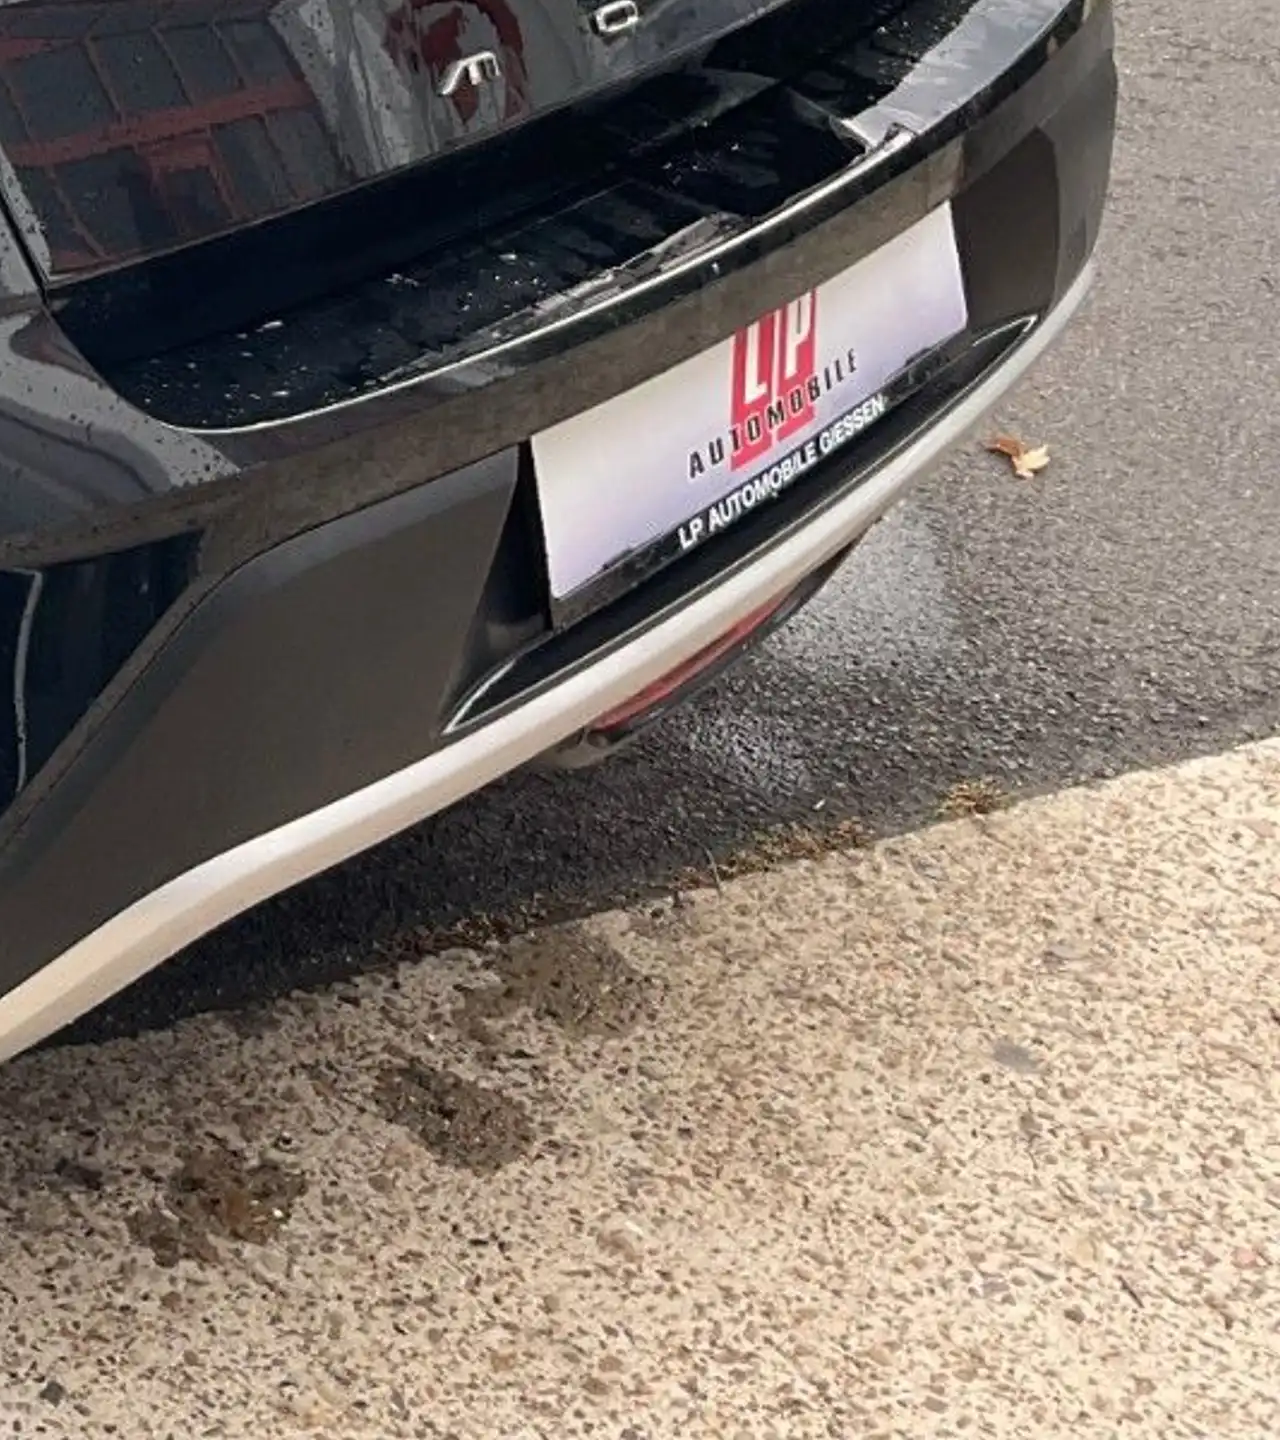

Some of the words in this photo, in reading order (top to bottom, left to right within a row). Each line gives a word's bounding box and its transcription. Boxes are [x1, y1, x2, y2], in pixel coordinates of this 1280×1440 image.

[689, 348, 858, 479] AUTOMOBILE
[744, 291, 812, 405] LP
[678, 520, 703, 550] LP
[709, 443, 817, 532] AUTOMOBILE
[819, 394, 886, 455] GIESSEN
